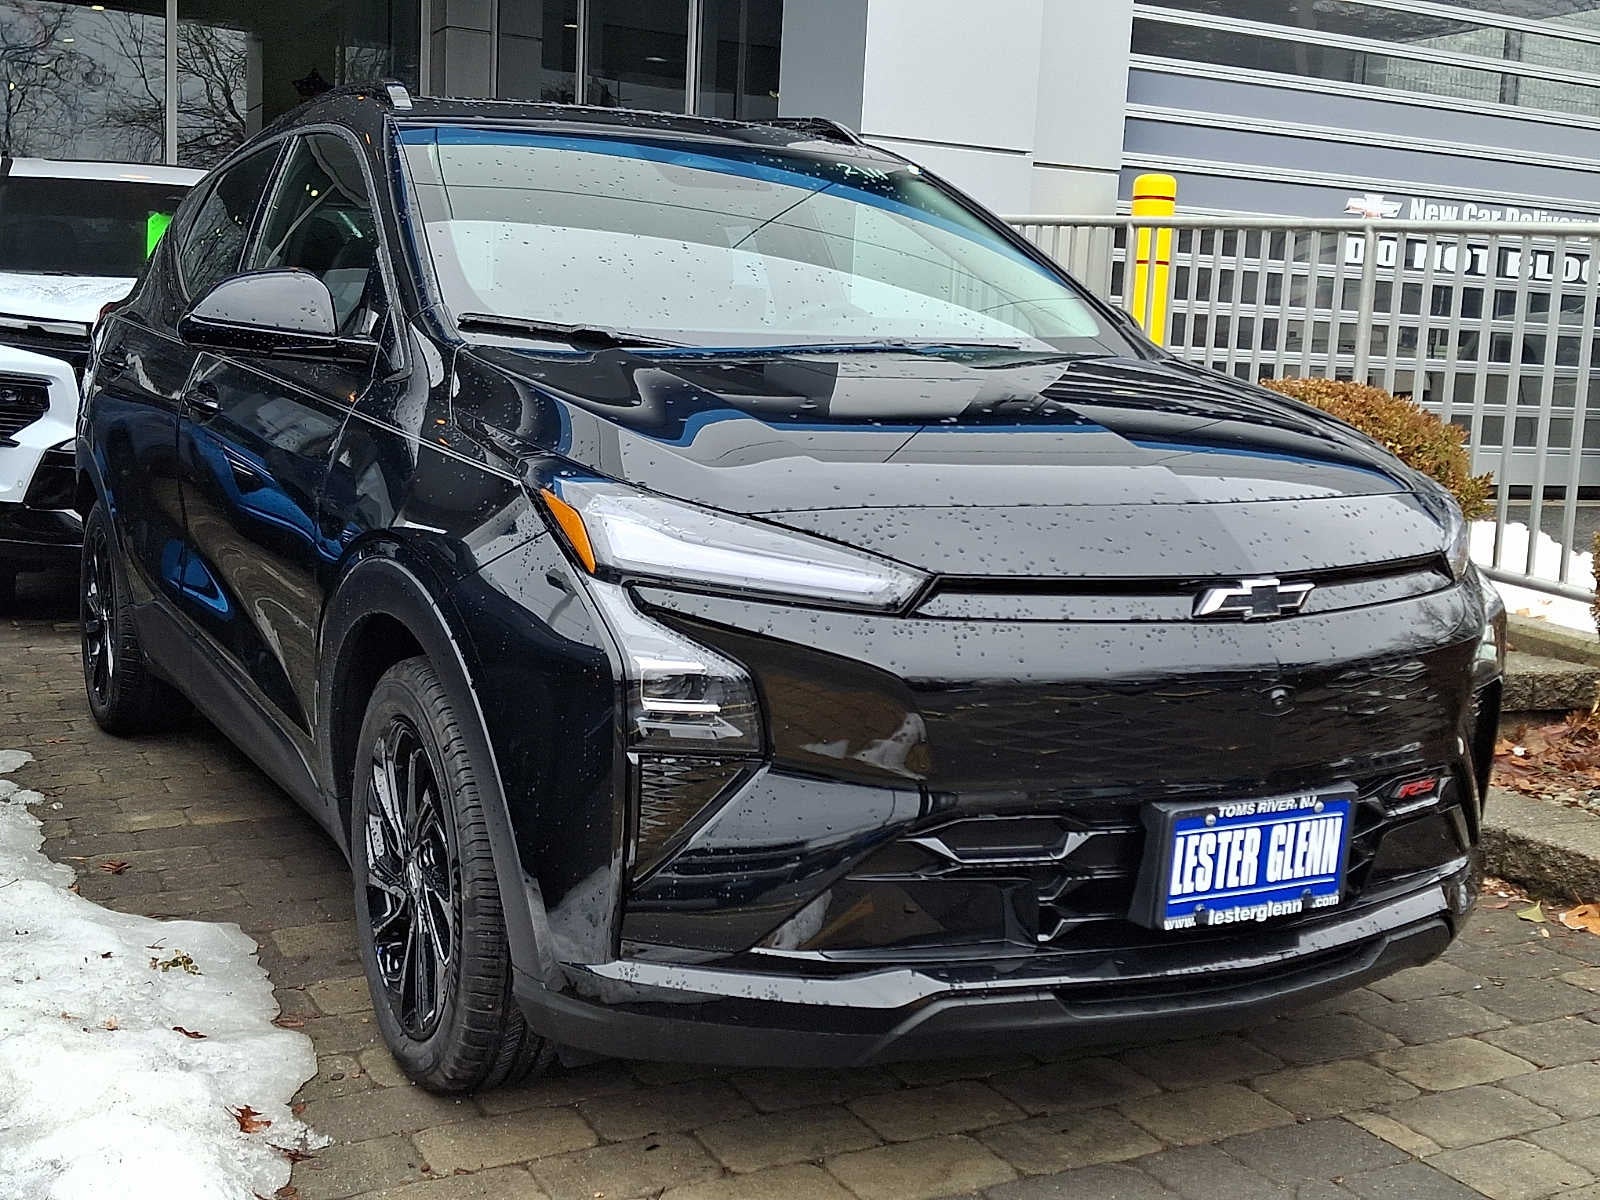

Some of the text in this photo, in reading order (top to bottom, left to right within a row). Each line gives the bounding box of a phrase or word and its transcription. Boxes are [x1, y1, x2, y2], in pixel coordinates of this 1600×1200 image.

[1409, 198, 1459, 222] New
[1462, 203, 1502, 223] Car
[1344, 237, 1398, 268] DO
[1398, 777, 1436, 799] RS
[1218, 803, 1256, 818] TOMS
[1299, 795, 1317, 809] NJ
[1170, 817, 1343, 896] LESTER GLENN
[1208, 899, 1303, 926] lesterglenn
